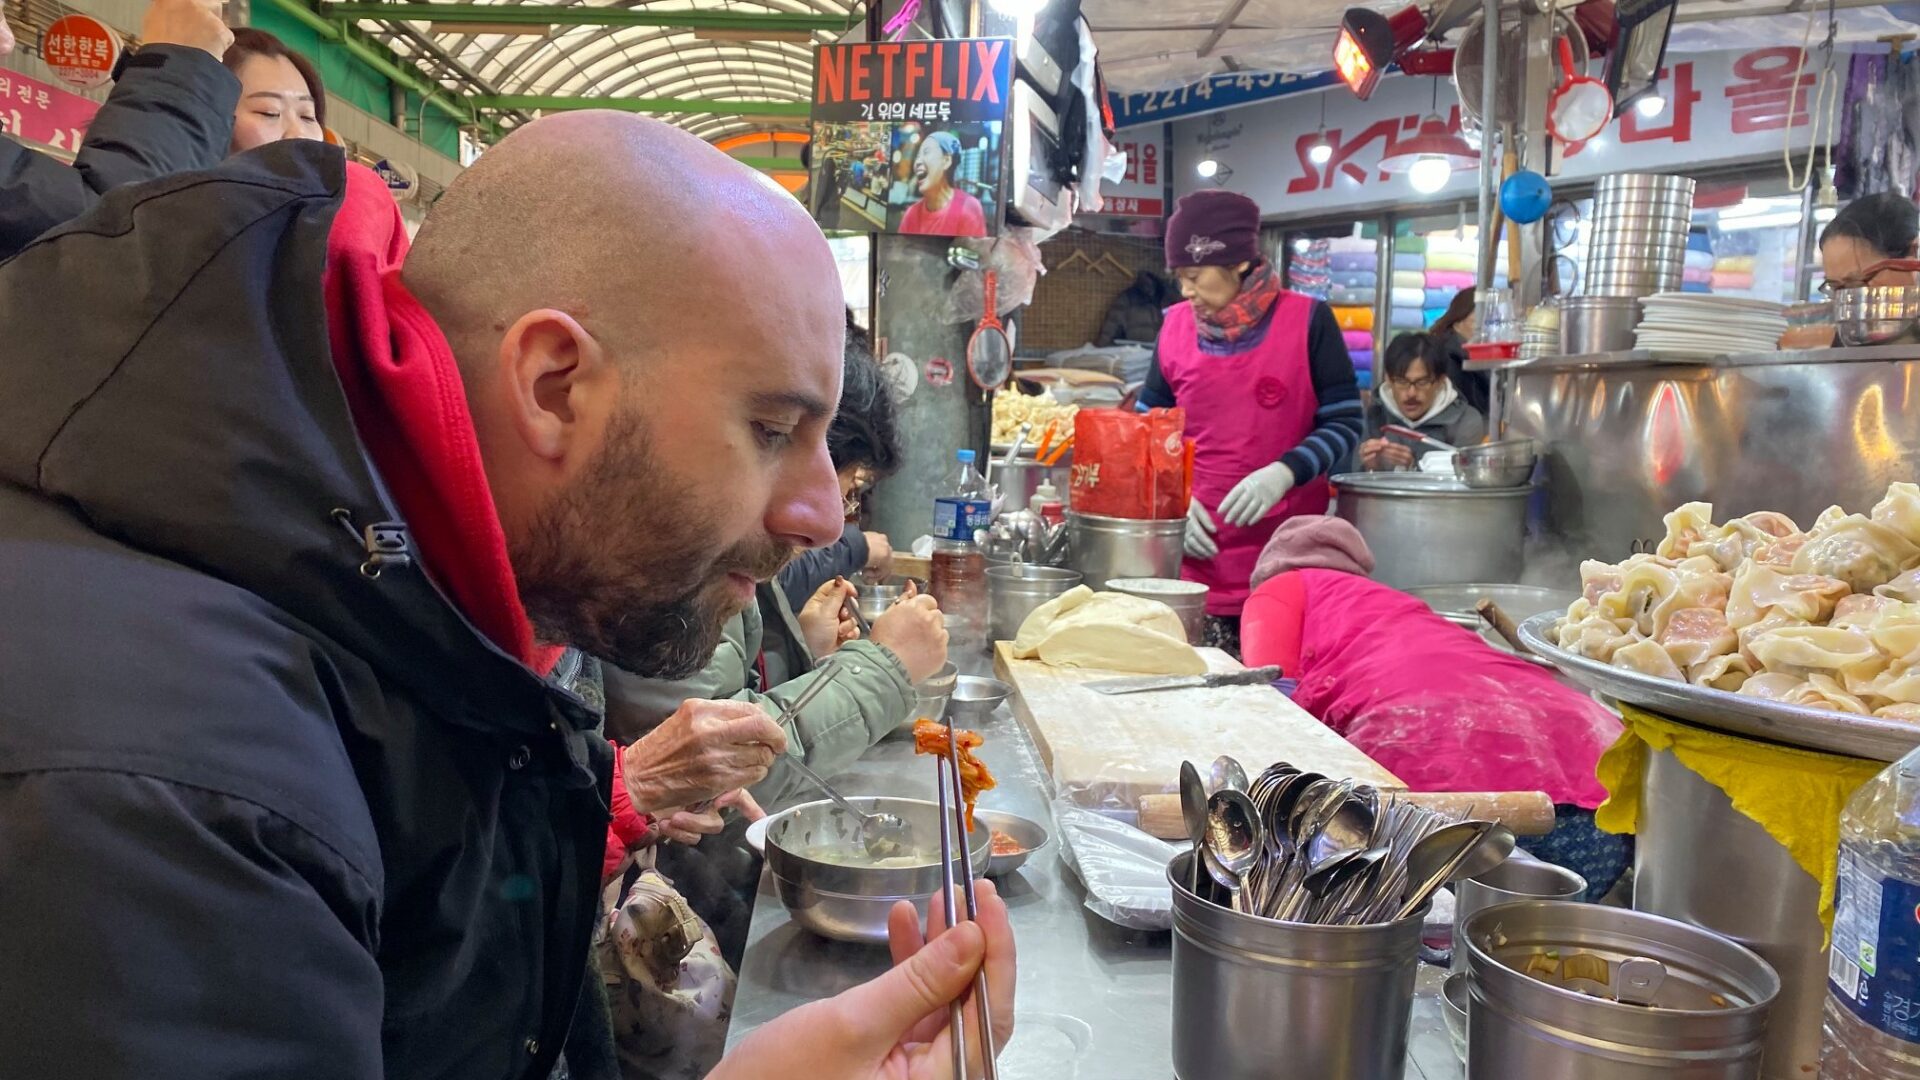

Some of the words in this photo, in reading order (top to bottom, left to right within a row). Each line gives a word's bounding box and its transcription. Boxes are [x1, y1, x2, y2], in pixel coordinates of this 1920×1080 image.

[817, 41, 1004, 104] NETFLIX
[17, 84, 51, 110] 전문
[861, 103, 874, 120] 길
[878, 102, 906, 120] 위의
